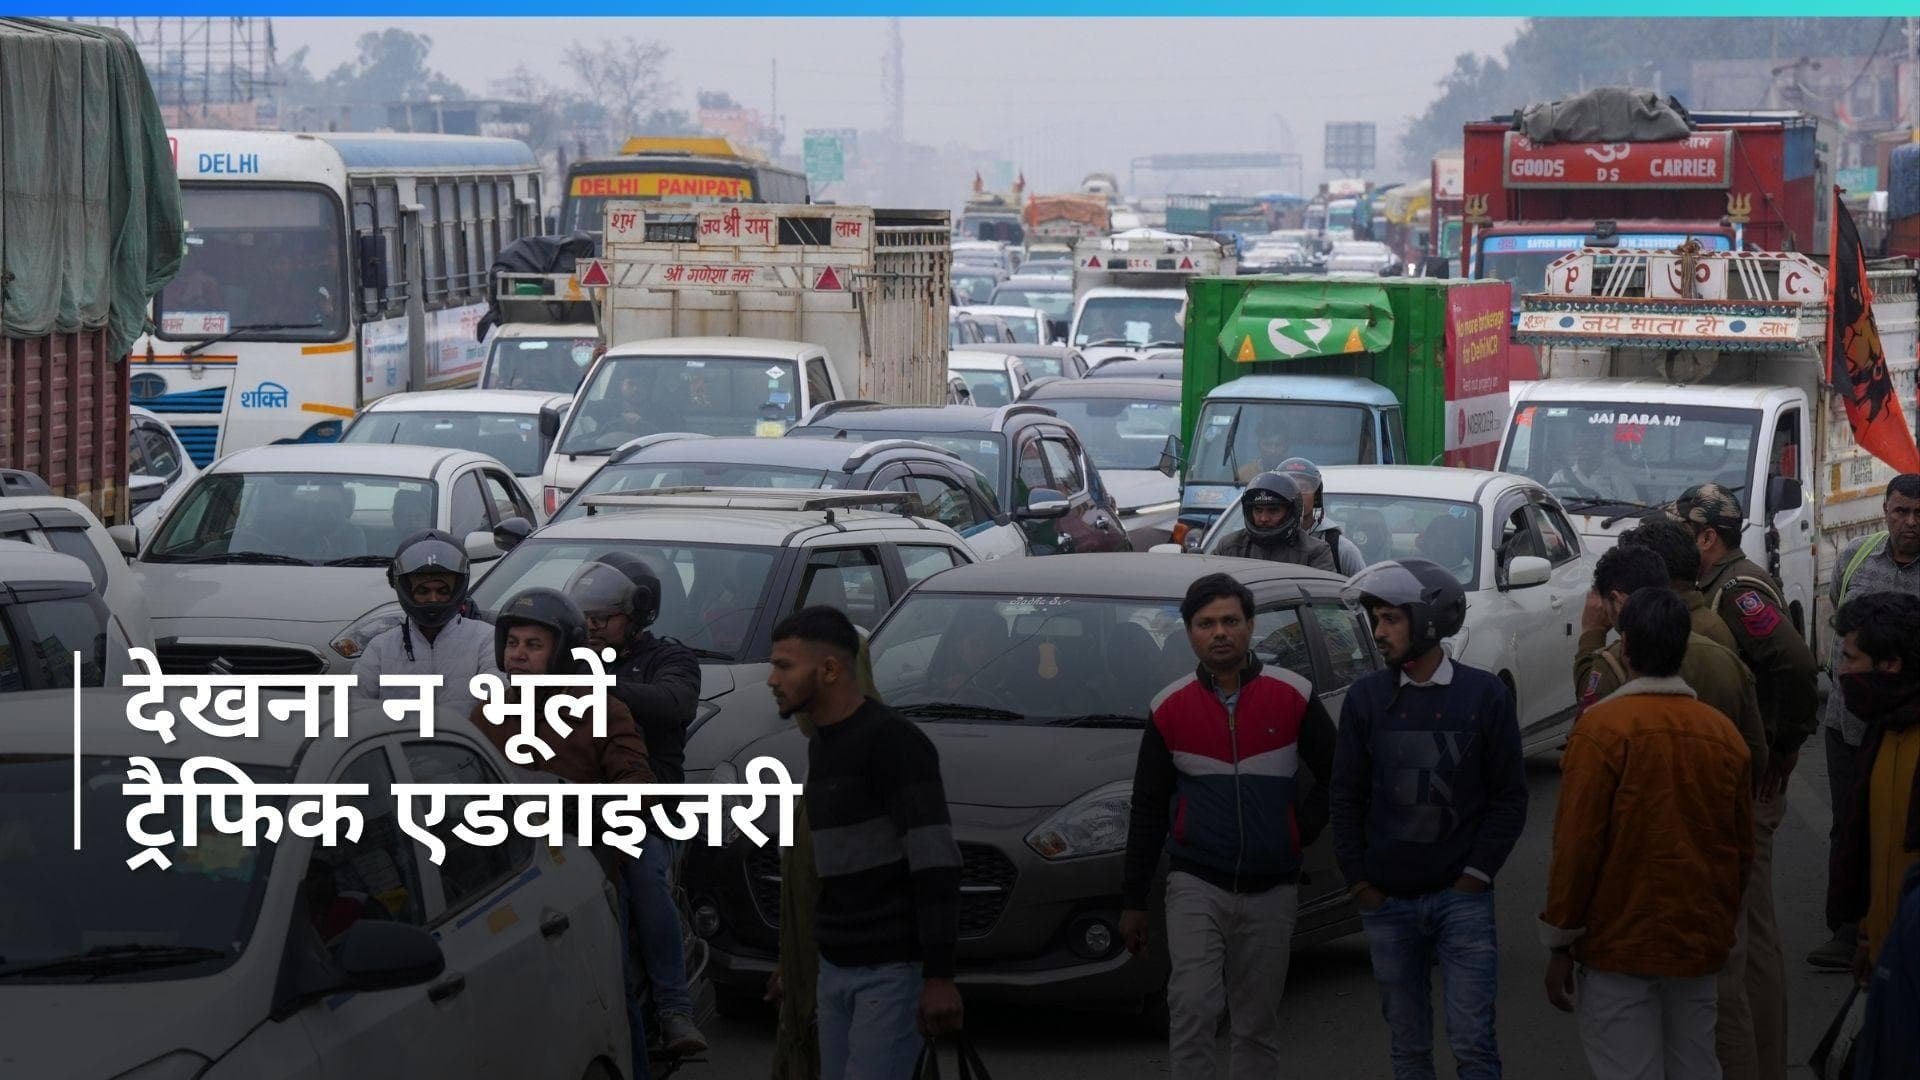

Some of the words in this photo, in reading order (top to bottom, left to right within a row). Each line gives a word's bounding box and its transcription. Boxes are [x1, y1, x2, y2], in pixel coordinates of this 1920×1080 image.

[198, 153, 258, 173] DELHI
[1511, 158, 1564, 177] GOODS
[1650, 158, 1716, 177] CARRIER
[580, 178, 638, 195] DELHI
[658, 178, 741, 197] PANIPAT
[611, 212, 636, 233] शुभ
[700, 218, 721, 235] जय
[723, 207, 741, 237] श्री
[835, 220, 862, 237] लाभ
[664, 264, 684, 281] श्री
[241, 382, 288, 408] शक्ति
[1588, 413, 1615, 424] JAI
[1618, 413, 1660, 425] BABA
[1664, 415, 1681, 426] KI
